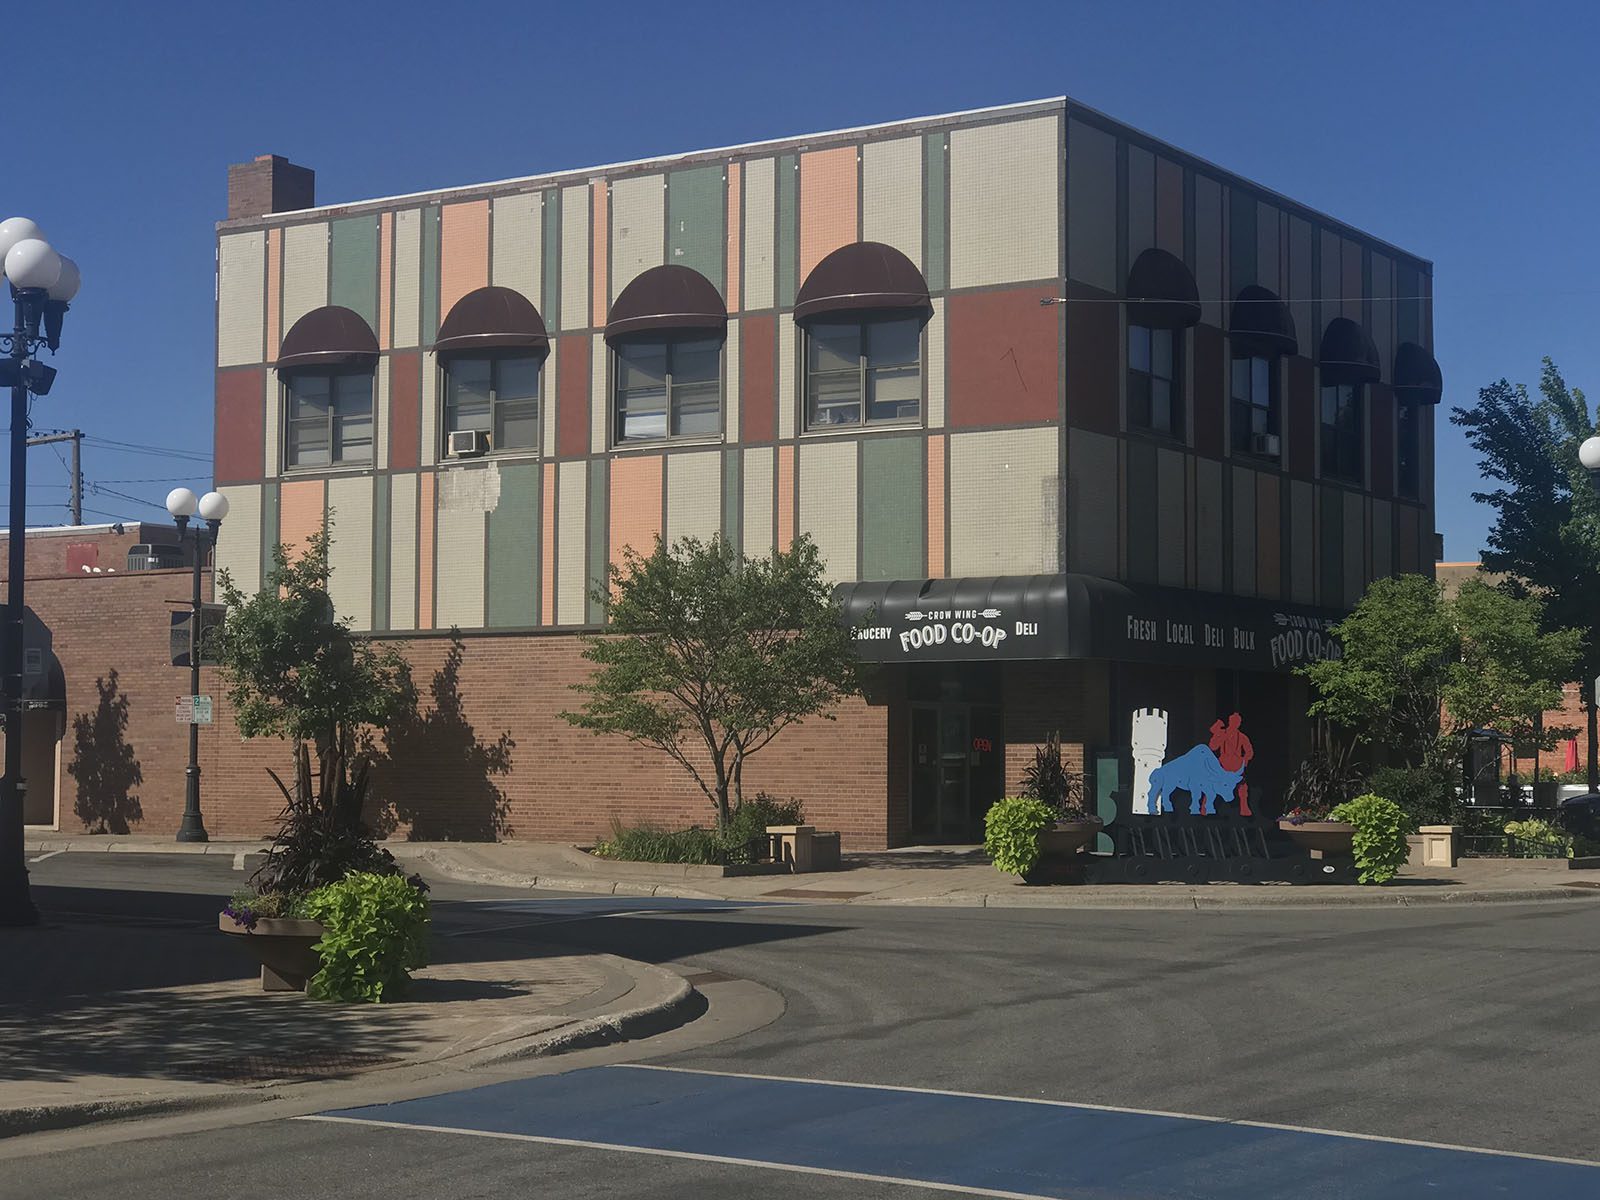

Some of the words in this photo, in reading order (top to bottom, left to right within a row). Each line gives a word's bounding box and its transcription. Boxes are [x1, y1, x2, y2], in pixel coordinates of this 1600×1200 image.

[928, 610, 951, 621] CROW
[954, 609, 977, 620] WING
[1015, 621, 1038, 636] DELI
[900, 623, 948, 653] FOOD
[951, 622, 1007, 649] CO-OP
[1127, 615, 1157, 641] FRESH
[1166, 619, 1194, 645] LOCAL
[1204, 623, 1225, 648] DELI
[1233, 627, 1255, 650] BULK
[1270, 629, 1303, 670] FOOD
